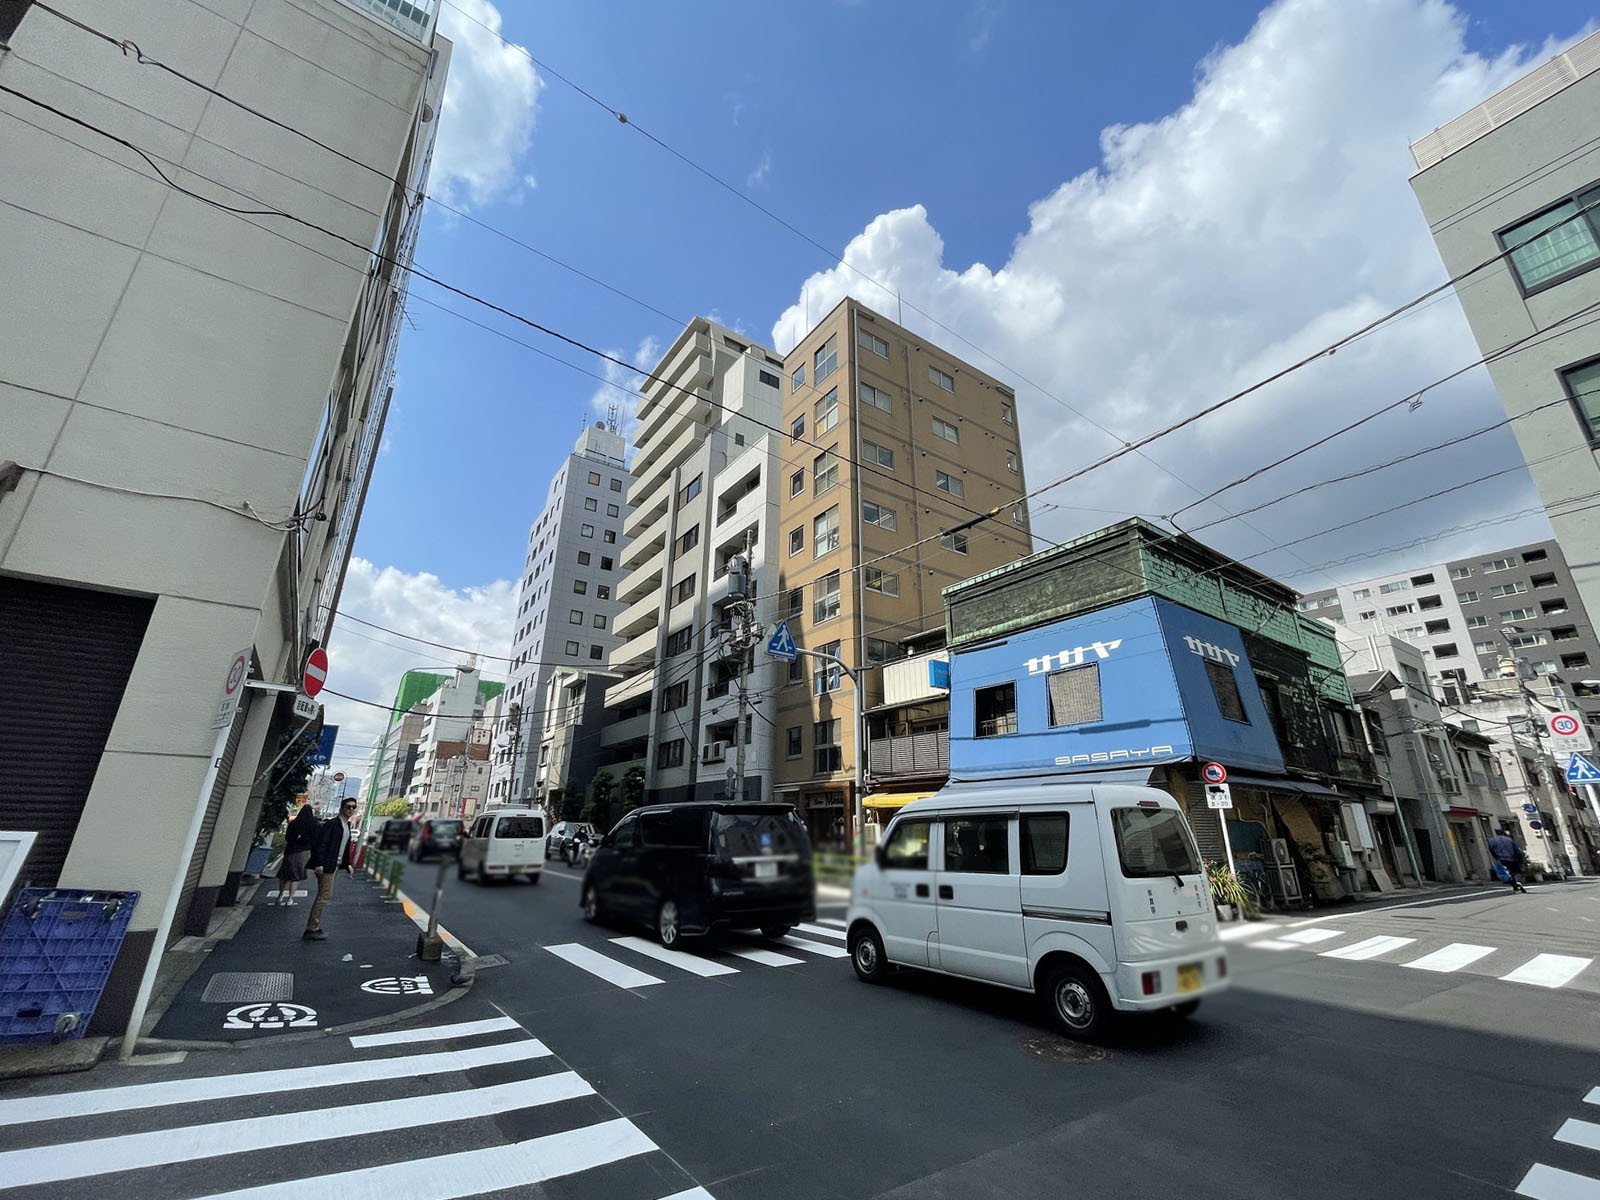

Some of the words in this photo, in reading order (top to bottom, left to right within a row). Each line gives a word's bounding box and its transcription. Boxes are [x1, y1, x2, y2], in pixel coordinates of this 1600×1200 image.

[1023, 639, 1123, 676] ササヤ
[1183, 635, 1240, 667] ササヤ
[1557, 720, 1573, 730] 30
[1055, 745, 1173, 766] SASAYA
